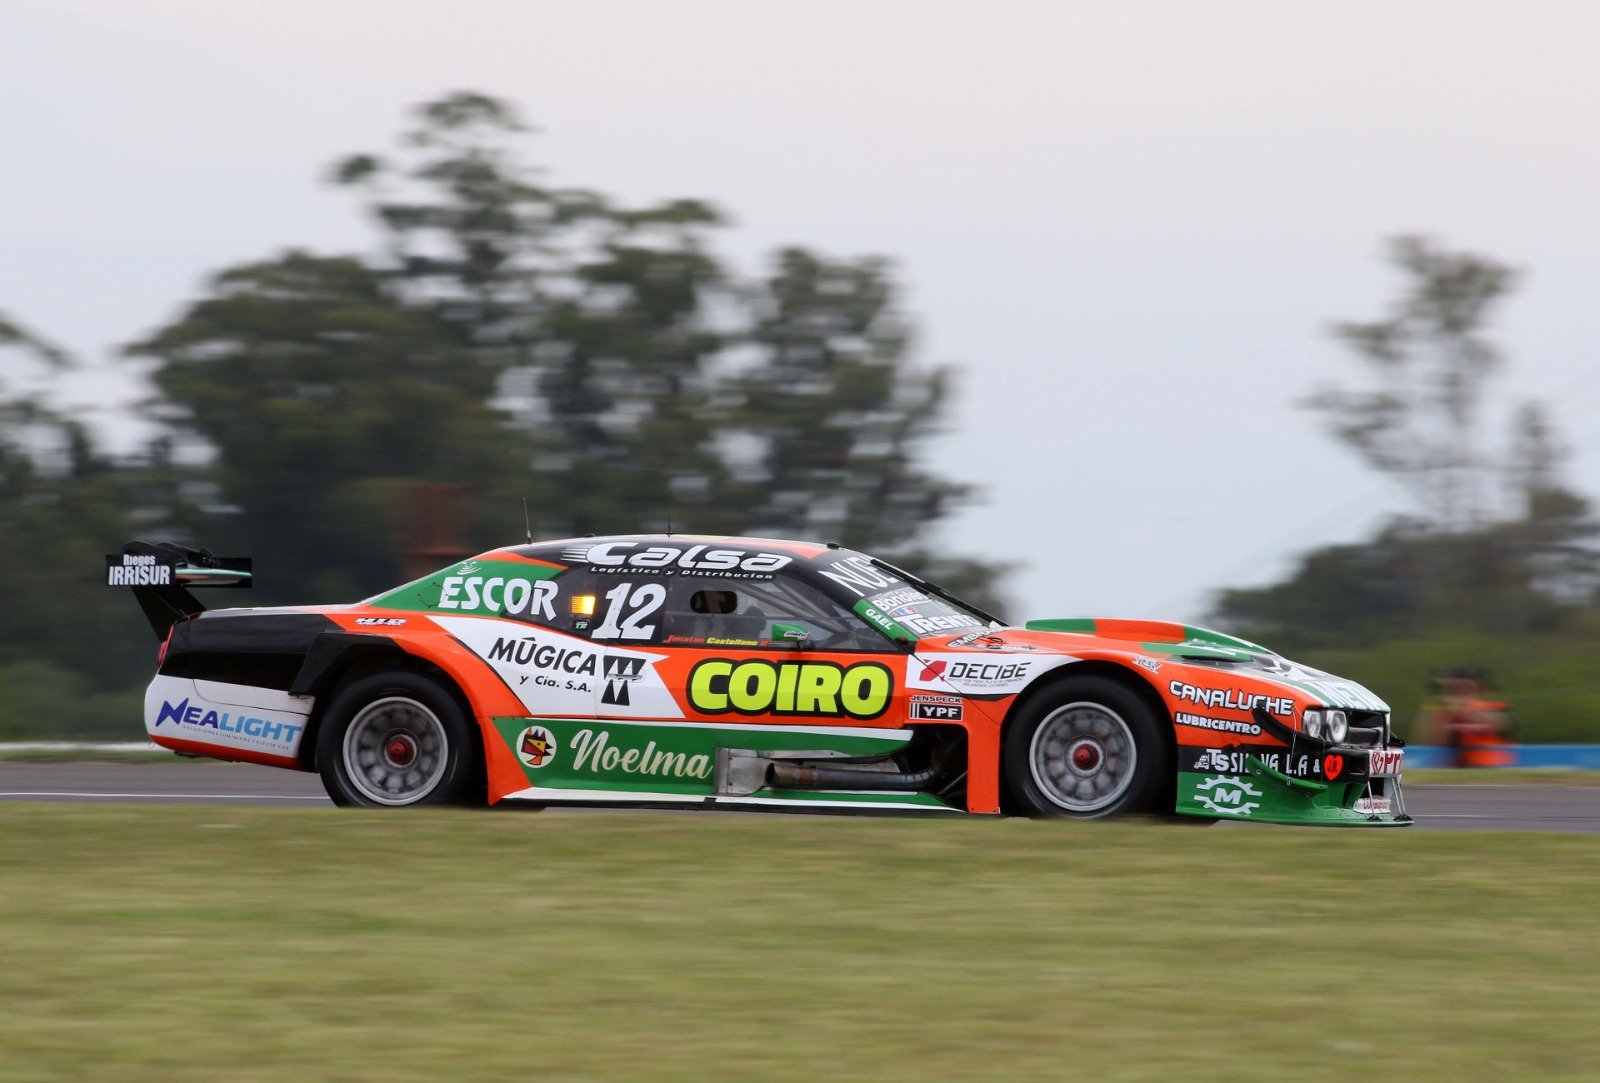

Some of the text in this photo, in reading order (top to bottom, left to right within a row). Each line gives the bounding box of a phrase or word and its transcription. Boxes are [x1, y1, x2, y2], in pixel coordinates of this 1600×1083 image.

[123, 554, 156, 566] Riegos
[586, 542, 793, 572] Calsa
[108, 565, 171, 586] IRRISUR
[437, 576, 559, 622] ESCOR
[590, 582, 667, 640] 12
[865, 607, 894, 631] GAEL
[706, 636, 759, 647] Castellano
[487, 636, 597, 677] MÚGICA
[948, 661, 1032, 680] DECIBE
[519, 674, 530, 686] y
[564, 680, 592, 693] S.A.
[690, 661, 890, 716] COIRO
[910, 695, 962, 704] JENSPECK
[1169, 680, 1295, 716] CANALUCHE
[922, 705, 959, 718] YPF
[1175, 712, 1262, 736] LUBRICENTRO
[569, 729, 715, 779] Noelma
[1312, 758, 1321, 774] &
[1213, 787, 1243, 805] M
